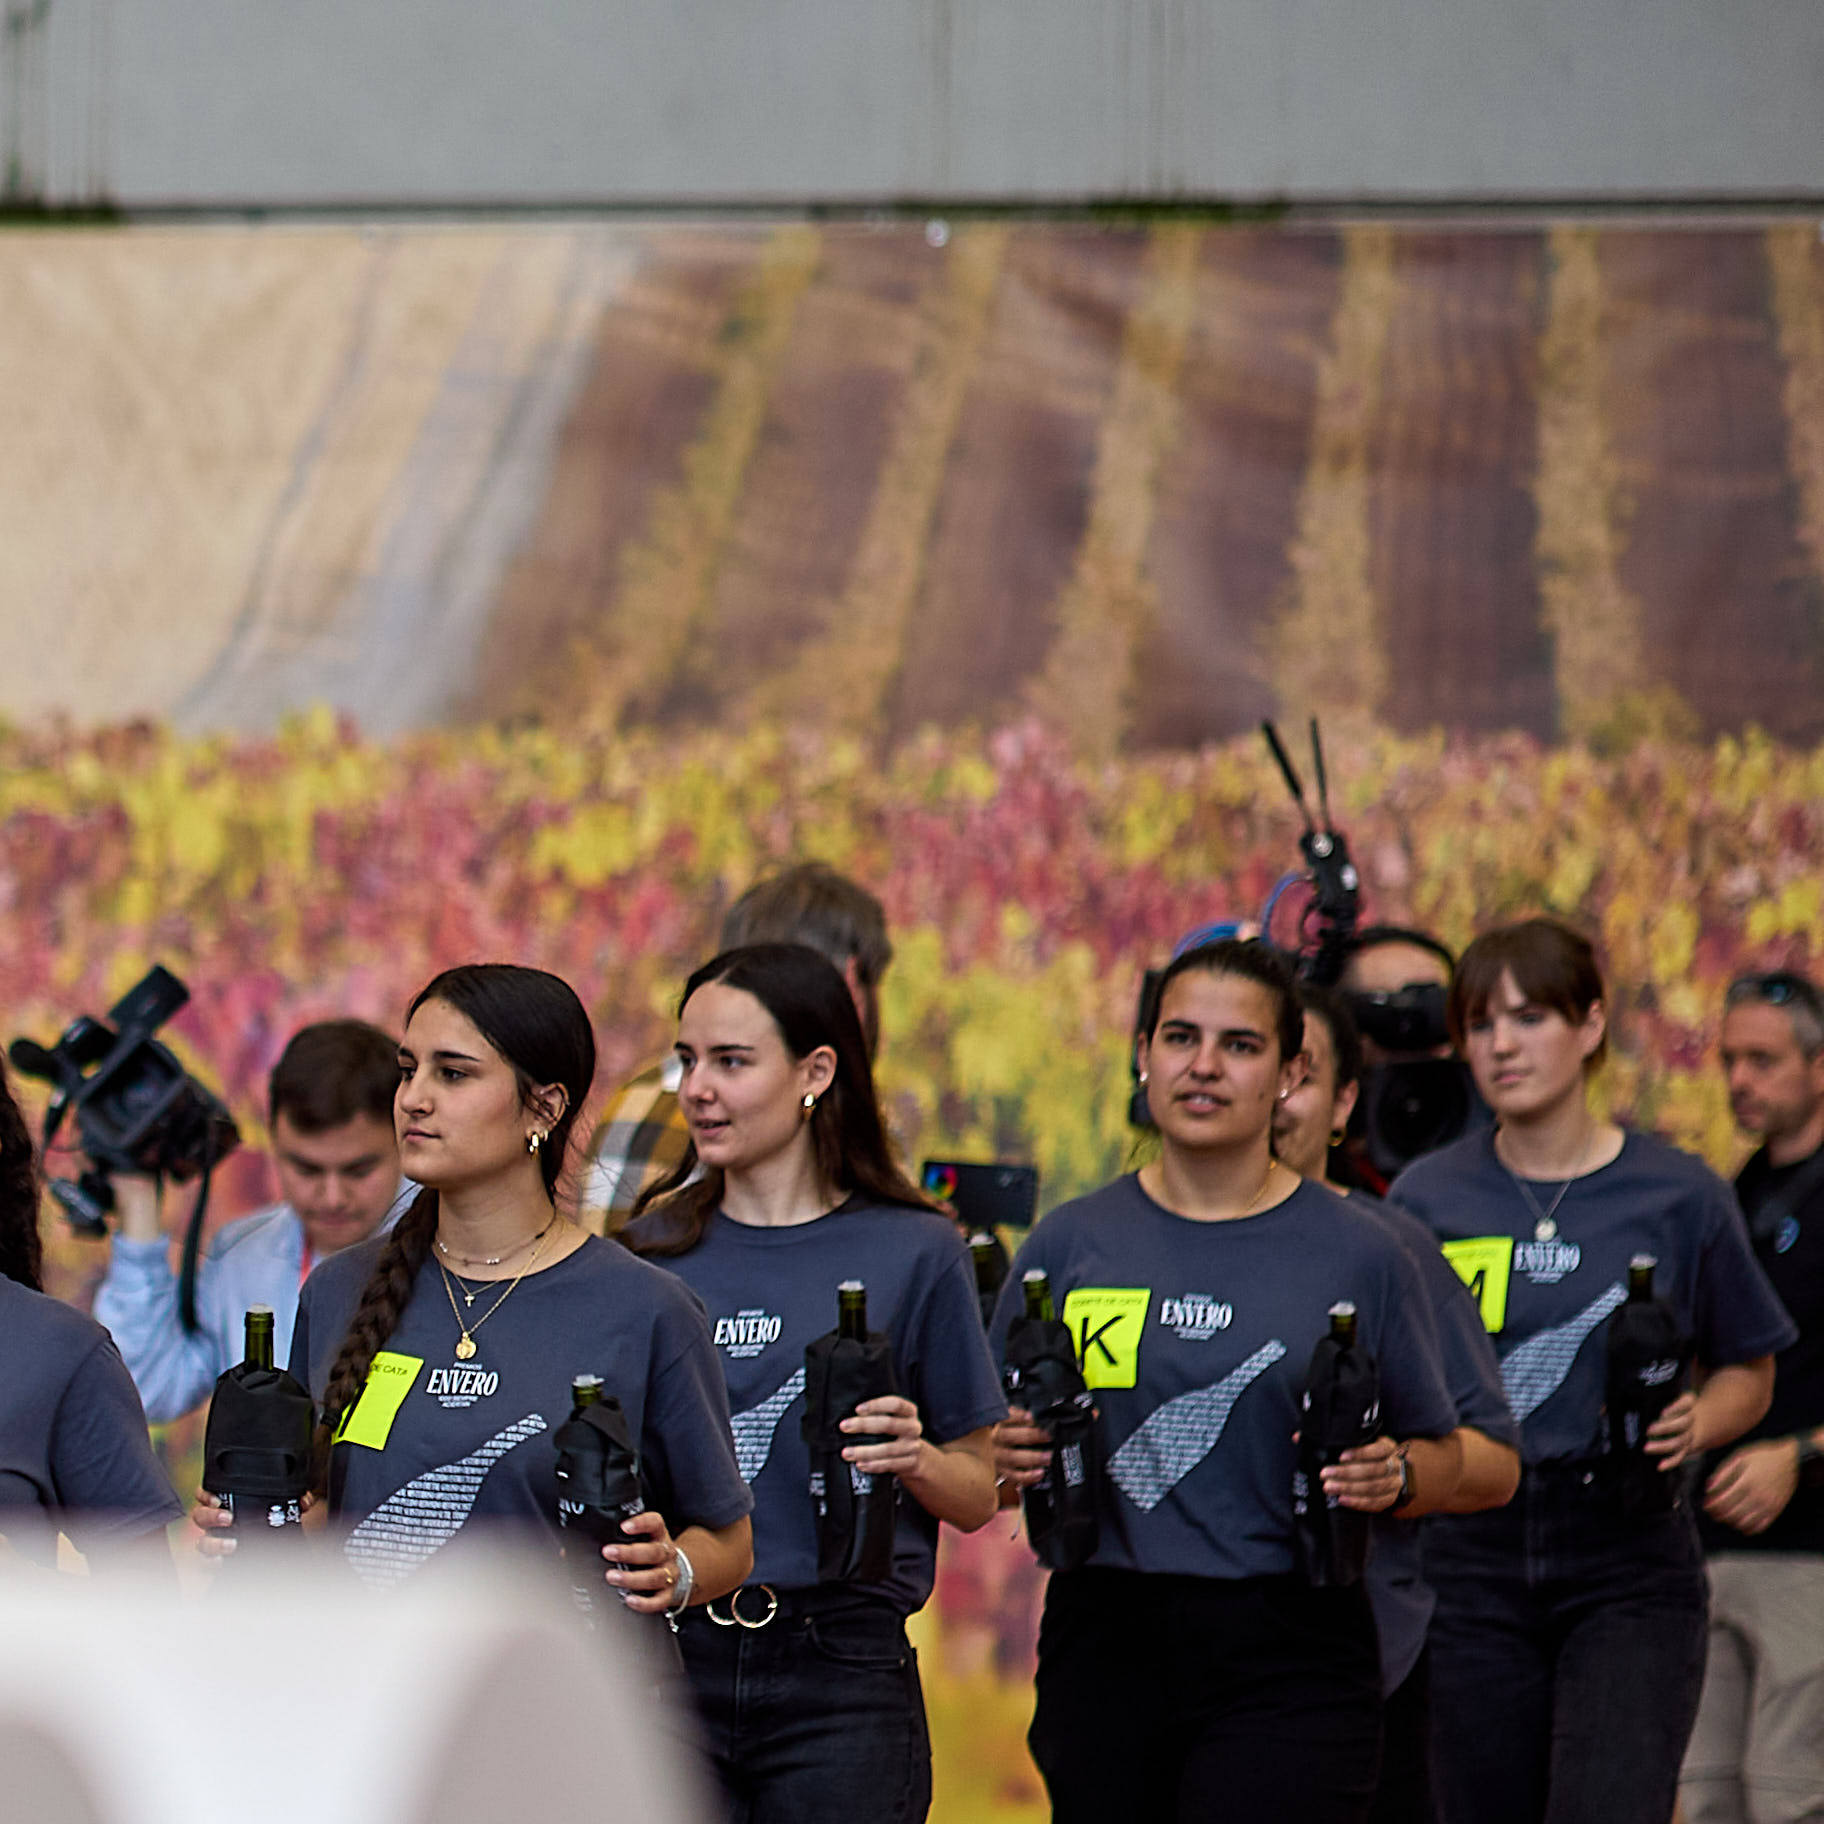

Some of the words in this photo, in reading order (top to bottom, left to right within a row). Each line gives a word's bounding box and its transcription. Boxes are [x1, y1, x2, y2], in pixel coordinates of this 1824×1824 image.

[1159, 1297, 1233, 1330] ENVERO
[713, 1315, 782, 1345] ENVERO
[1081, 1314, 1126, 1374] K
[383, 1364, 408, 1376] CATA
[425, 1368, 499, 1396] ENVERO
